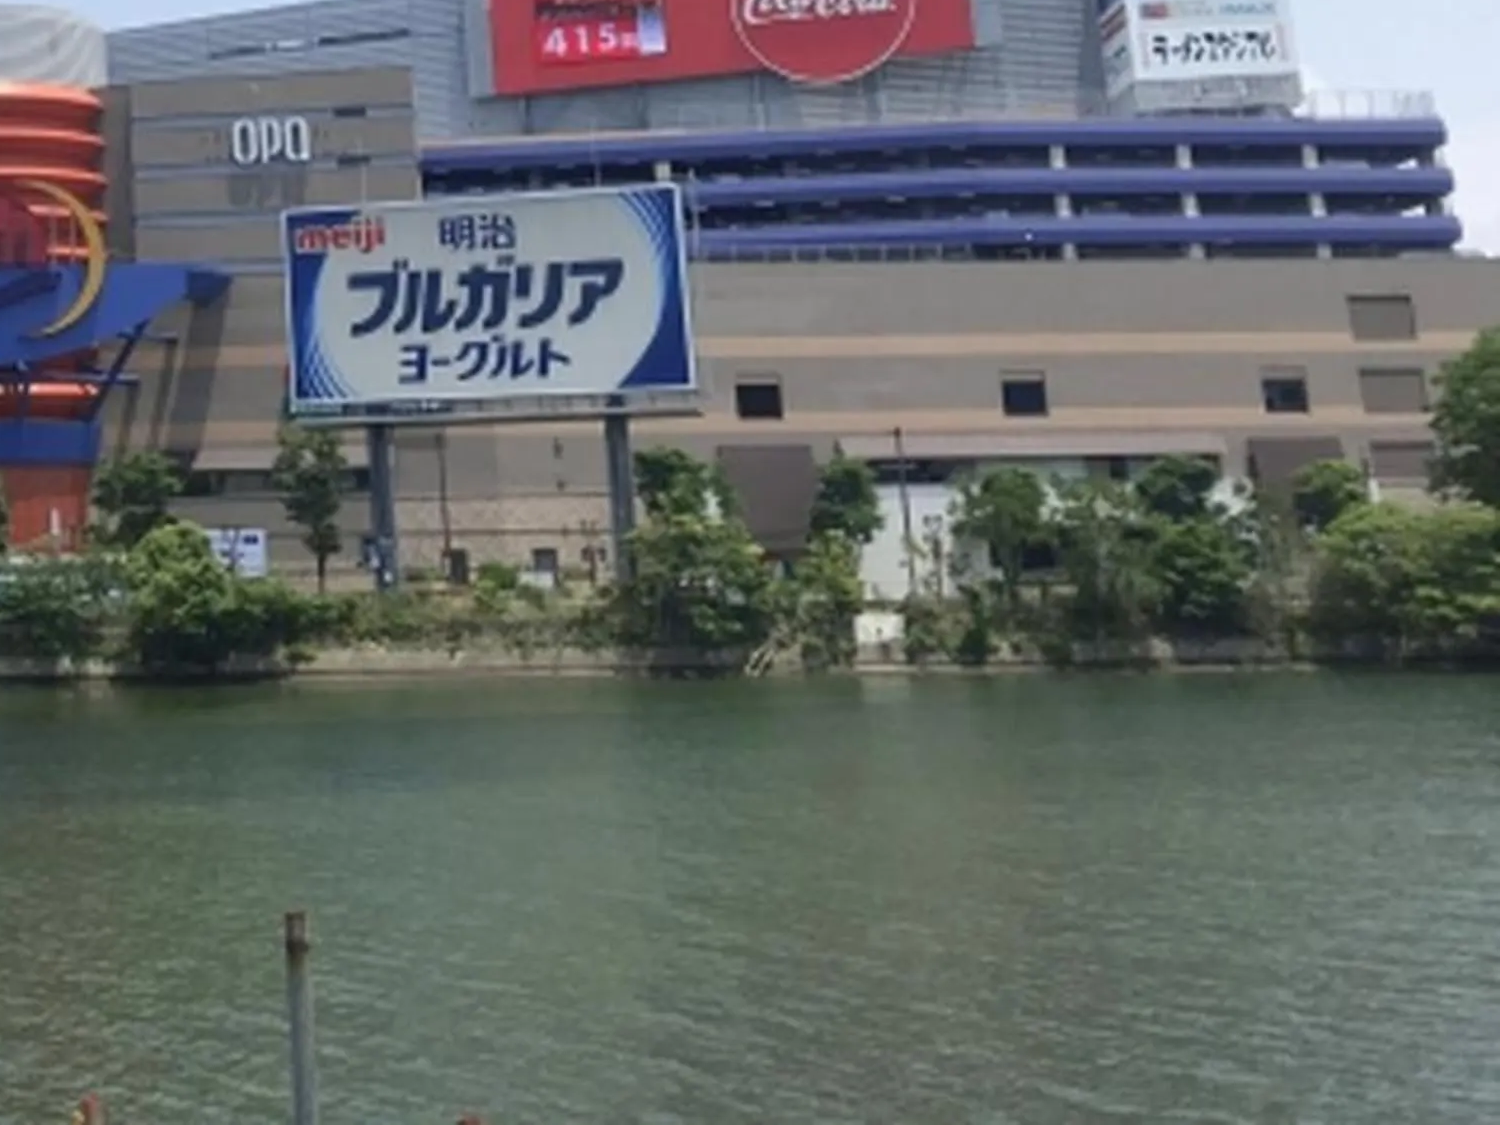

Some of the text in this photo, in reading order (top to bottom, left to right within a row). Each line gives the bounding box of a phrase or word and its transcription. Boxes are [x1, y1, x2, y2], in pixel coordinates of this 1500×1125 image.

[298, 218, 386, 253] meiji
[437, 213, 517, 250] 明治
[347, 256, 625, 338] ブルガリア
[399, 336, 571, 383] ヨーグルト
